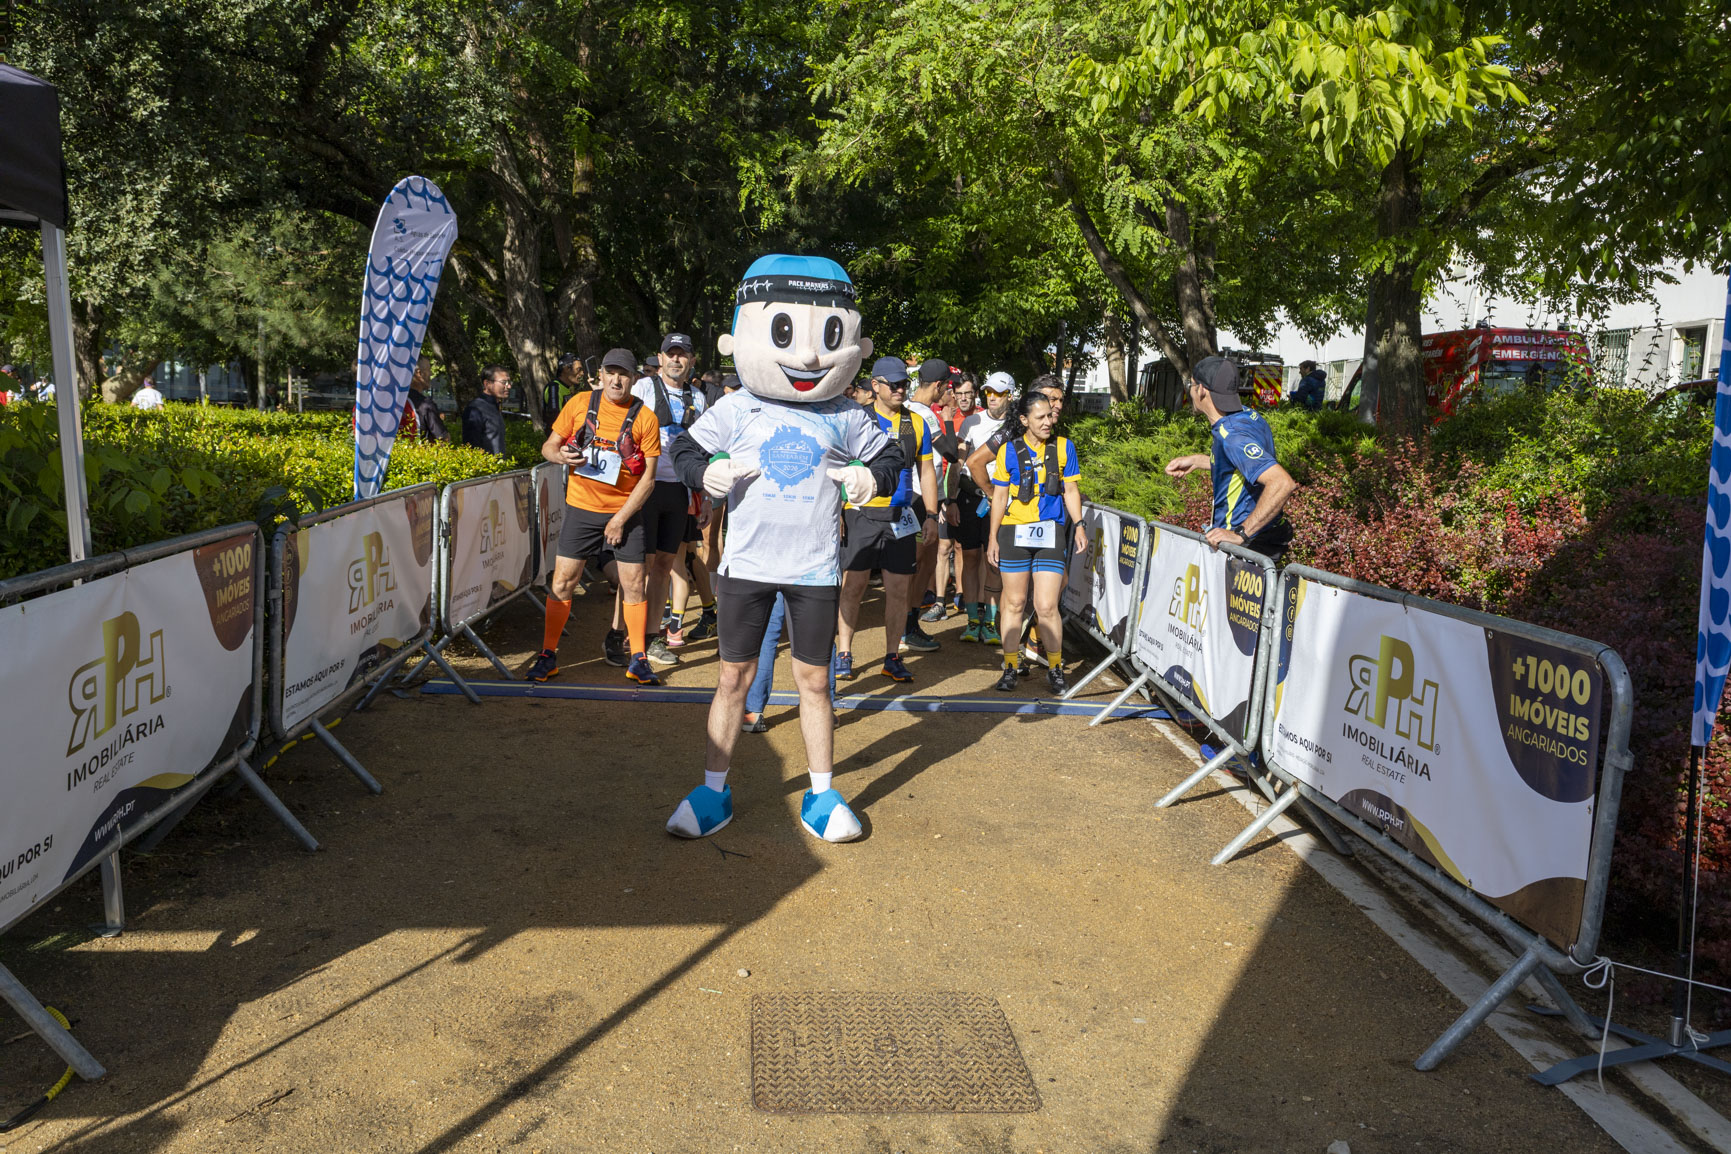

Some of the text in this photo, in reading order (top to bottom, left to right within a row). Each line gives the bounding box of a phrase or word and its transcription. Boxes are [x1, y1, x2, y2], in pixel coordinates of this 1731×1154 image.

[901, 513, 913, 526] 36
[1028, 526, 1044, 538] 70
[212, 543, 251, 578] +1000
[348, 531, 397, 615] RPH
[216, 575, 250, 608] IMÓVEIS
[1232, 570, 1263, 598] +1000
[216, 598, 250, 625] ANGARIADOS
[1229, 612, 1259, 633] ANGARIADOS
[1230, 593, 1261, 619] IMÓVEIS
[1167, 622, 1203, 654] IMOBILIÁRIA
[66, 611, 166, 758] RPH
[285, 675, 314, 698] ESTAMOS
[314, 667, 328, 683] AQUI
[328, 662, 340, 675] POR
[1344, 634, 1439, 752] RPH
[1512, 655, 1591, 706] +1000
[1510, 694, 1590, 742] IMÓVEIS
[67, 714, 165, 792] IMOBILIÁRIA
[1299, 737, 1314, 752] AQUI
[1314, 744, 1326, 760] POR
[1326, 751, 1332, 764] SI
[1343, 722, 1432, 781] IMOBILIÁRIA
[1507, 723, 1588, 766] ANGARIADOS
[93, 751, 135, 794] REAL ESTATE
[1361, 754, 1406, 784] REAL ESTATE
[1361, 797, 1404, 831] WWW.RPH.PT
[17, 842, 41, 871] POR
[43, 834, 53, 853] SI
